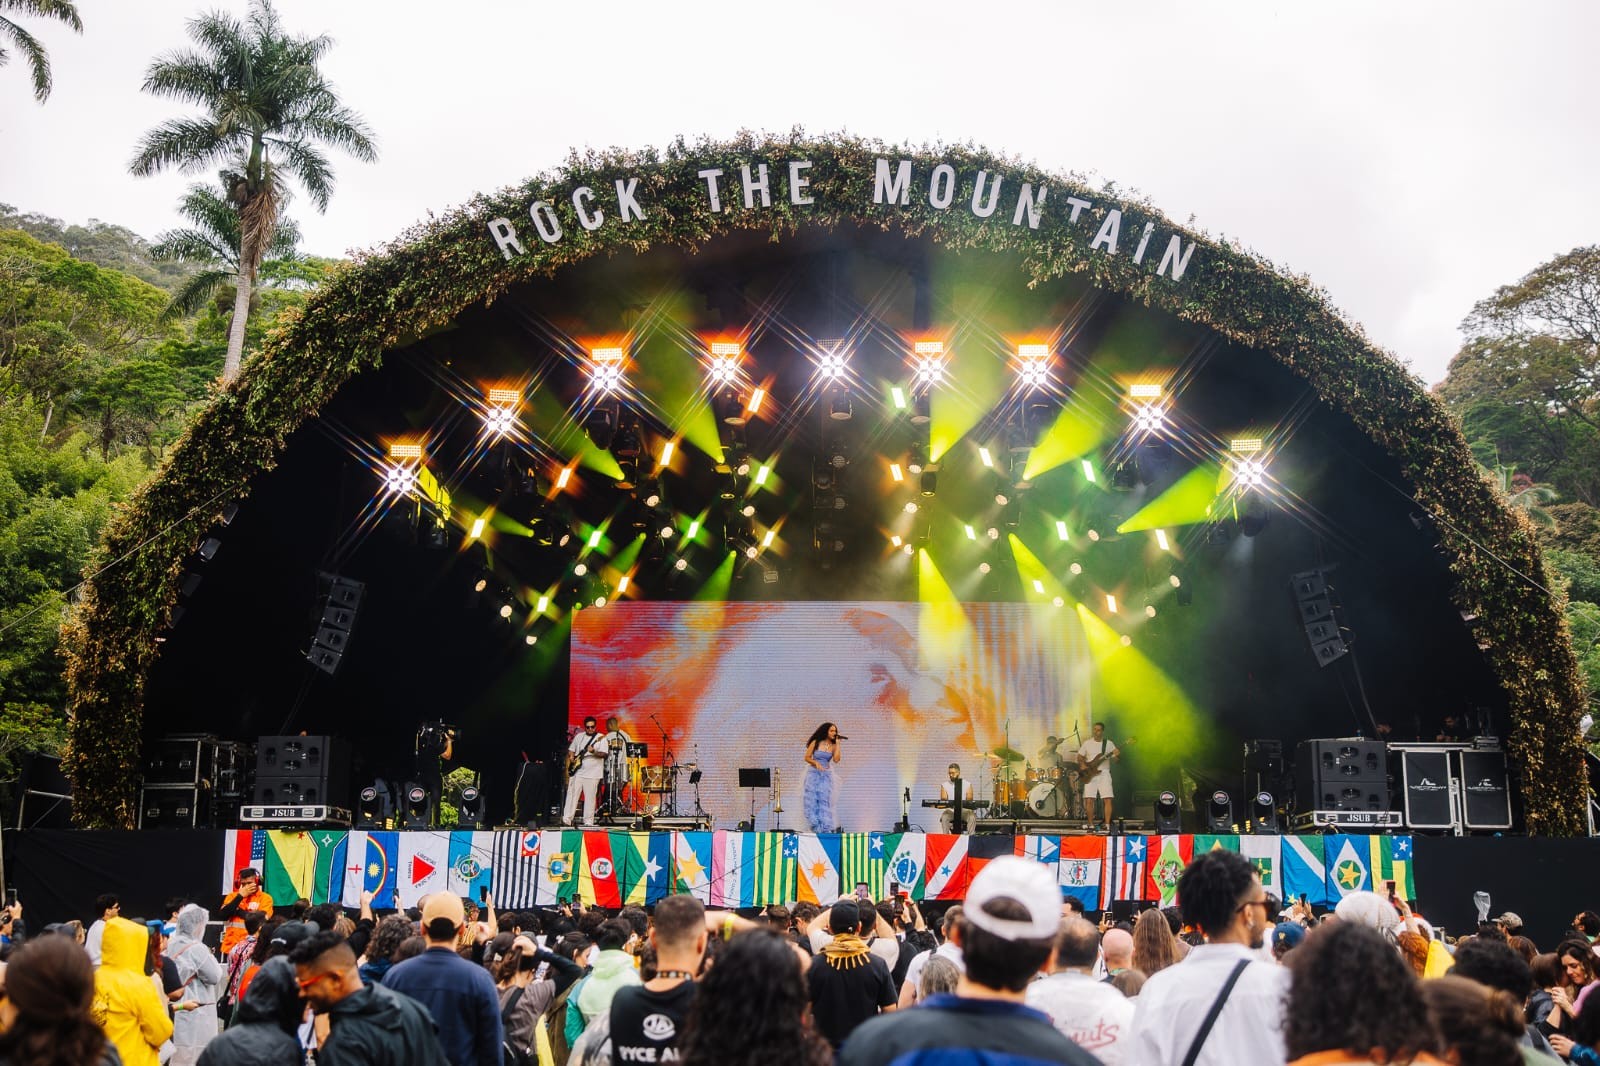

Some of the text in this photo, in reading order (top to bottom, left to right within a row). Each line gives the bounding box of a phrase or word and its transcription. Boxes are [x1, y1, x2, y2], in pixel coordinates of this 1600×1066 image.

[487, 158, 1196, 282] ROCK THE MOUNTAIN
[271, 808, 296, 817] JSUB
[1346, 813, 1371, 822] JSUB
